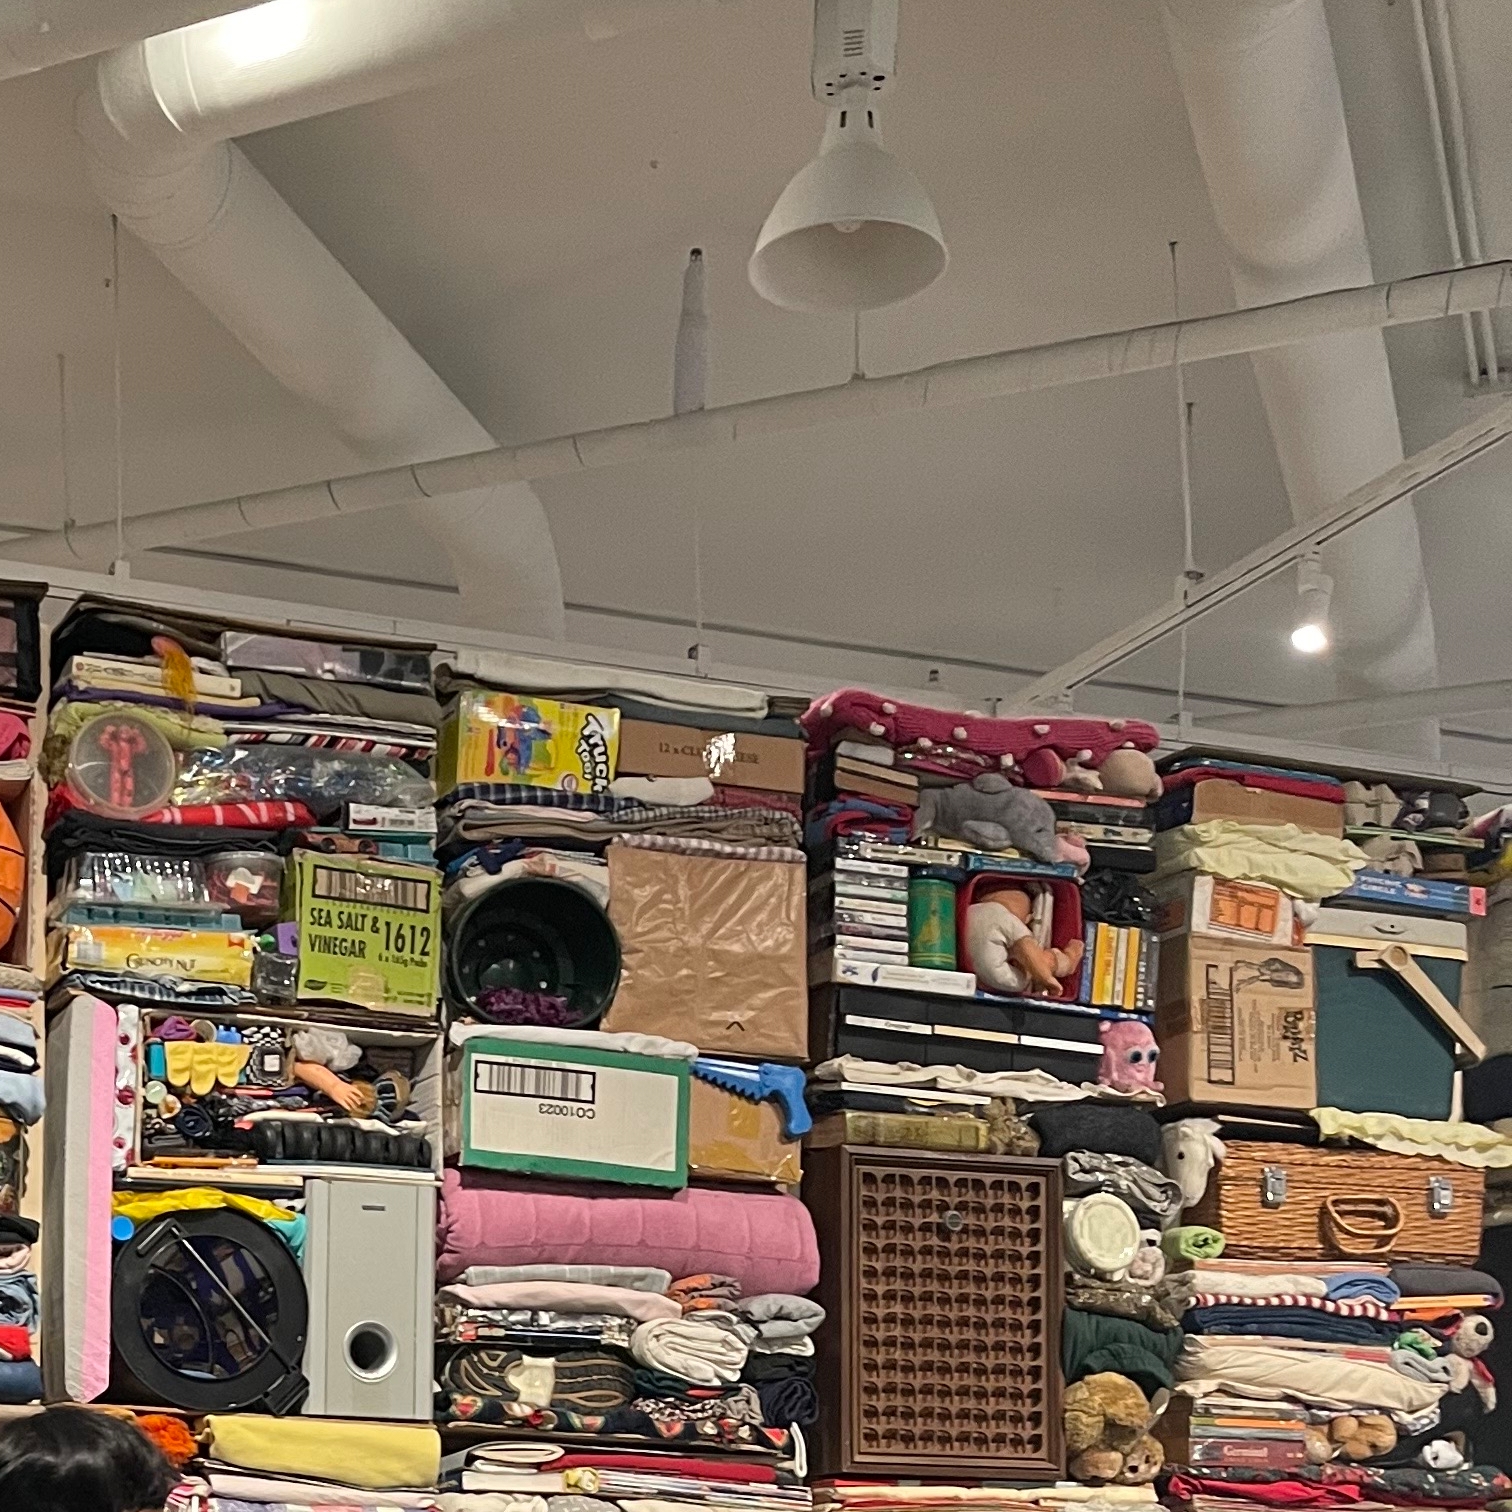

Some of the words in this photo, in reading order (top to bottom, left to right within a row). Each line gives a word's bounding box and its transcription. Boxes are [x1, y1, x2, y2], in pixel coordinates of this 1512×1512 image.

[310, 907, 334, 930] SEA
[337, 912, 367, 933] SALT
[370, 916, 380, 934] &
[308, 933, 367, 960] VINEGAR
[384, 920, 431, 957] 1612
[538, 1102, 596, 1121] CO10023
